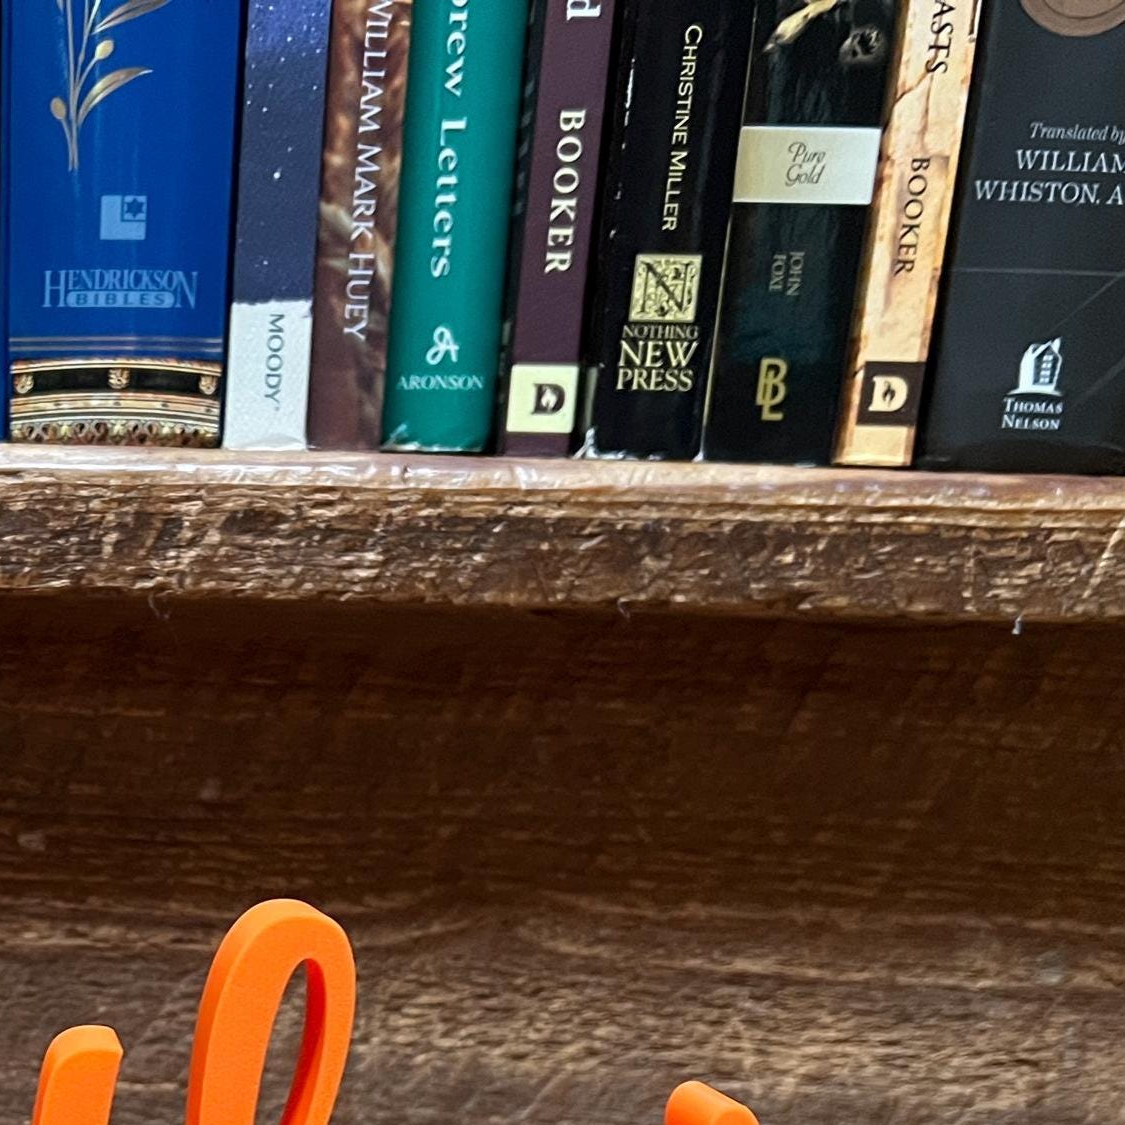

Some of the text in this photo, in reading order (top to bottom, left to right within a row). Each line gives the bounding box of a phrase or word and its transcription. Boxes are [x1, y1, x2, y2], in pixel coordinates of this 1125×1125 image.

[430, 0, 469, 279] rew Letters
[662, 24, 703, 232] CHRISTINE MILLER
[1029, 121, 1110, 142] Translated
[788, 141, 826, 164] Pure
[784, 164, 826, 187] Gold
[350, 142, 383, 241] MARK
[543, 108, 587, 274] BOOKER
[894, 157, 932, 277] BOOKER
[42, 268, 199, 309] HENDRICKSON
[75, 292, 167, 306] BIBLES
[343, 252, 375, 341] HUEY
[622, 325, 700, 340] NOTHING
[263, 313, 286, 405] MOODY
[617, 339, 701, 368] NEW
[396, 374, 486, 391] ARONSON
[615, 367, 695, 392] PRESS
[1002, 396, 1064, 413] THOMAS
[1001, 413, 1061, 430] NELSON
